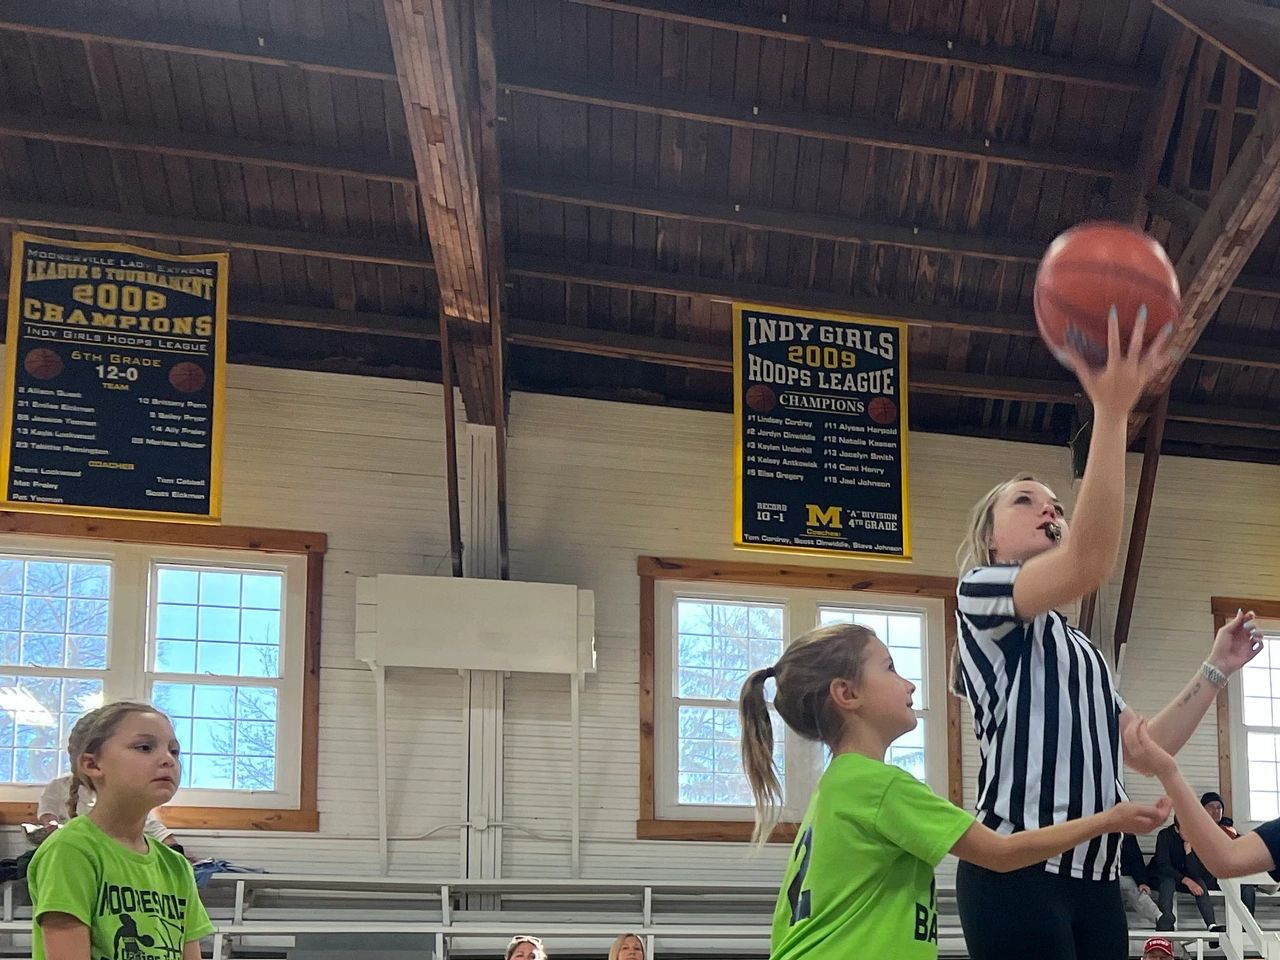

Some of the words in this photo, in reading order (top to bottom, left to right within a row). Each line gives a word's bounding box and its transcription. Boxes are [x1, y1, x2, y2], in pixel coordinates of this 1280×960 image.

[27, 259, 88, 282] LEAGUE
[105, 267, 214, 301] TOURNAMENT
[24, 297, 213, 337] CHAMPIONS
[27, 326, 57, 337] INDY
[63, 330, 102, 343] GIRLS
[107, 334, 152, 347] HOOPS
[159, 339, 208, 352] LEAGUE
[748, 317, 814, 346] INDY
[819, 325, 893, 360] GIRLS
[110, 353, 162, 368] GRADE
[788, 345, 856, 369] 2009
[95, 364, 139, 382] 12-0
[748, 353, 811, 387] HOOPS
[818, 368, 894, 395] LEAGUE
[102, 382, 130, 391] TEAM
[779, 393, 865, 413] CHAMPIONS
[838, 437, 866, 446] Natalie
[870, 453, 895, 462] Smith
[861, 465, 885, 475] Henry
[858, 478, 891, 488] Johnson
[756, 502, 788, 512] RECORD
[862, 510, 898, 520] DIVISION
[805, 504, 843, 529] M
[848, 518, 864, 528] 4TH
[865, 520, 898, 531] GRADE
